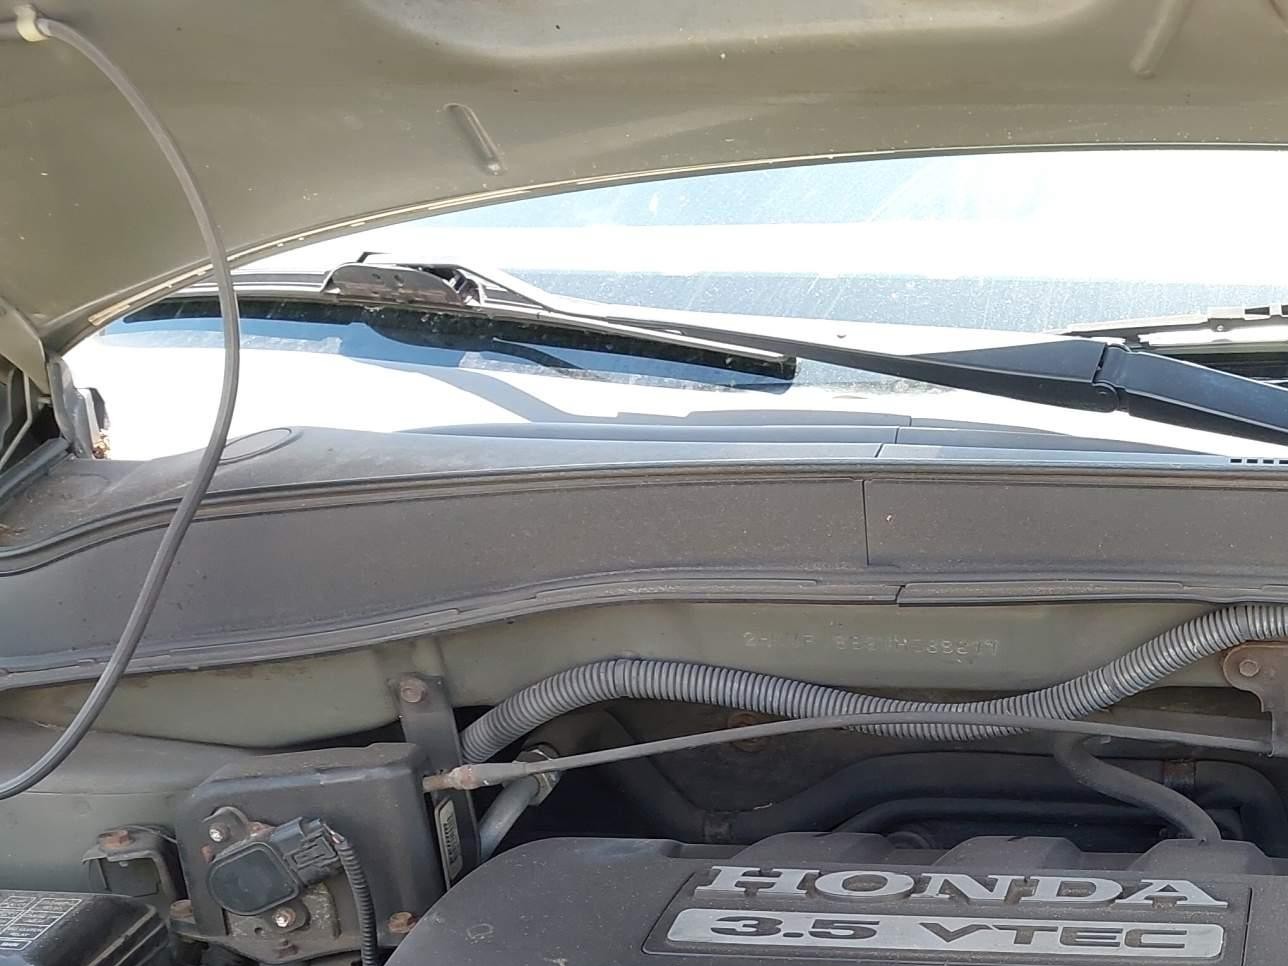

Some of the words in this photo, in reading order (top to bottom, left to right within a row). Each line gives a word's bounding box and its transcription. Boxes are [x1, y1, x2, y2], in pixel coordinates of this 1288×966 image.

[694, 865, 1229, 909] HONDA
[710, 915, 881, 940] 3.5
[920, 921, 1190, 950] VTEC
